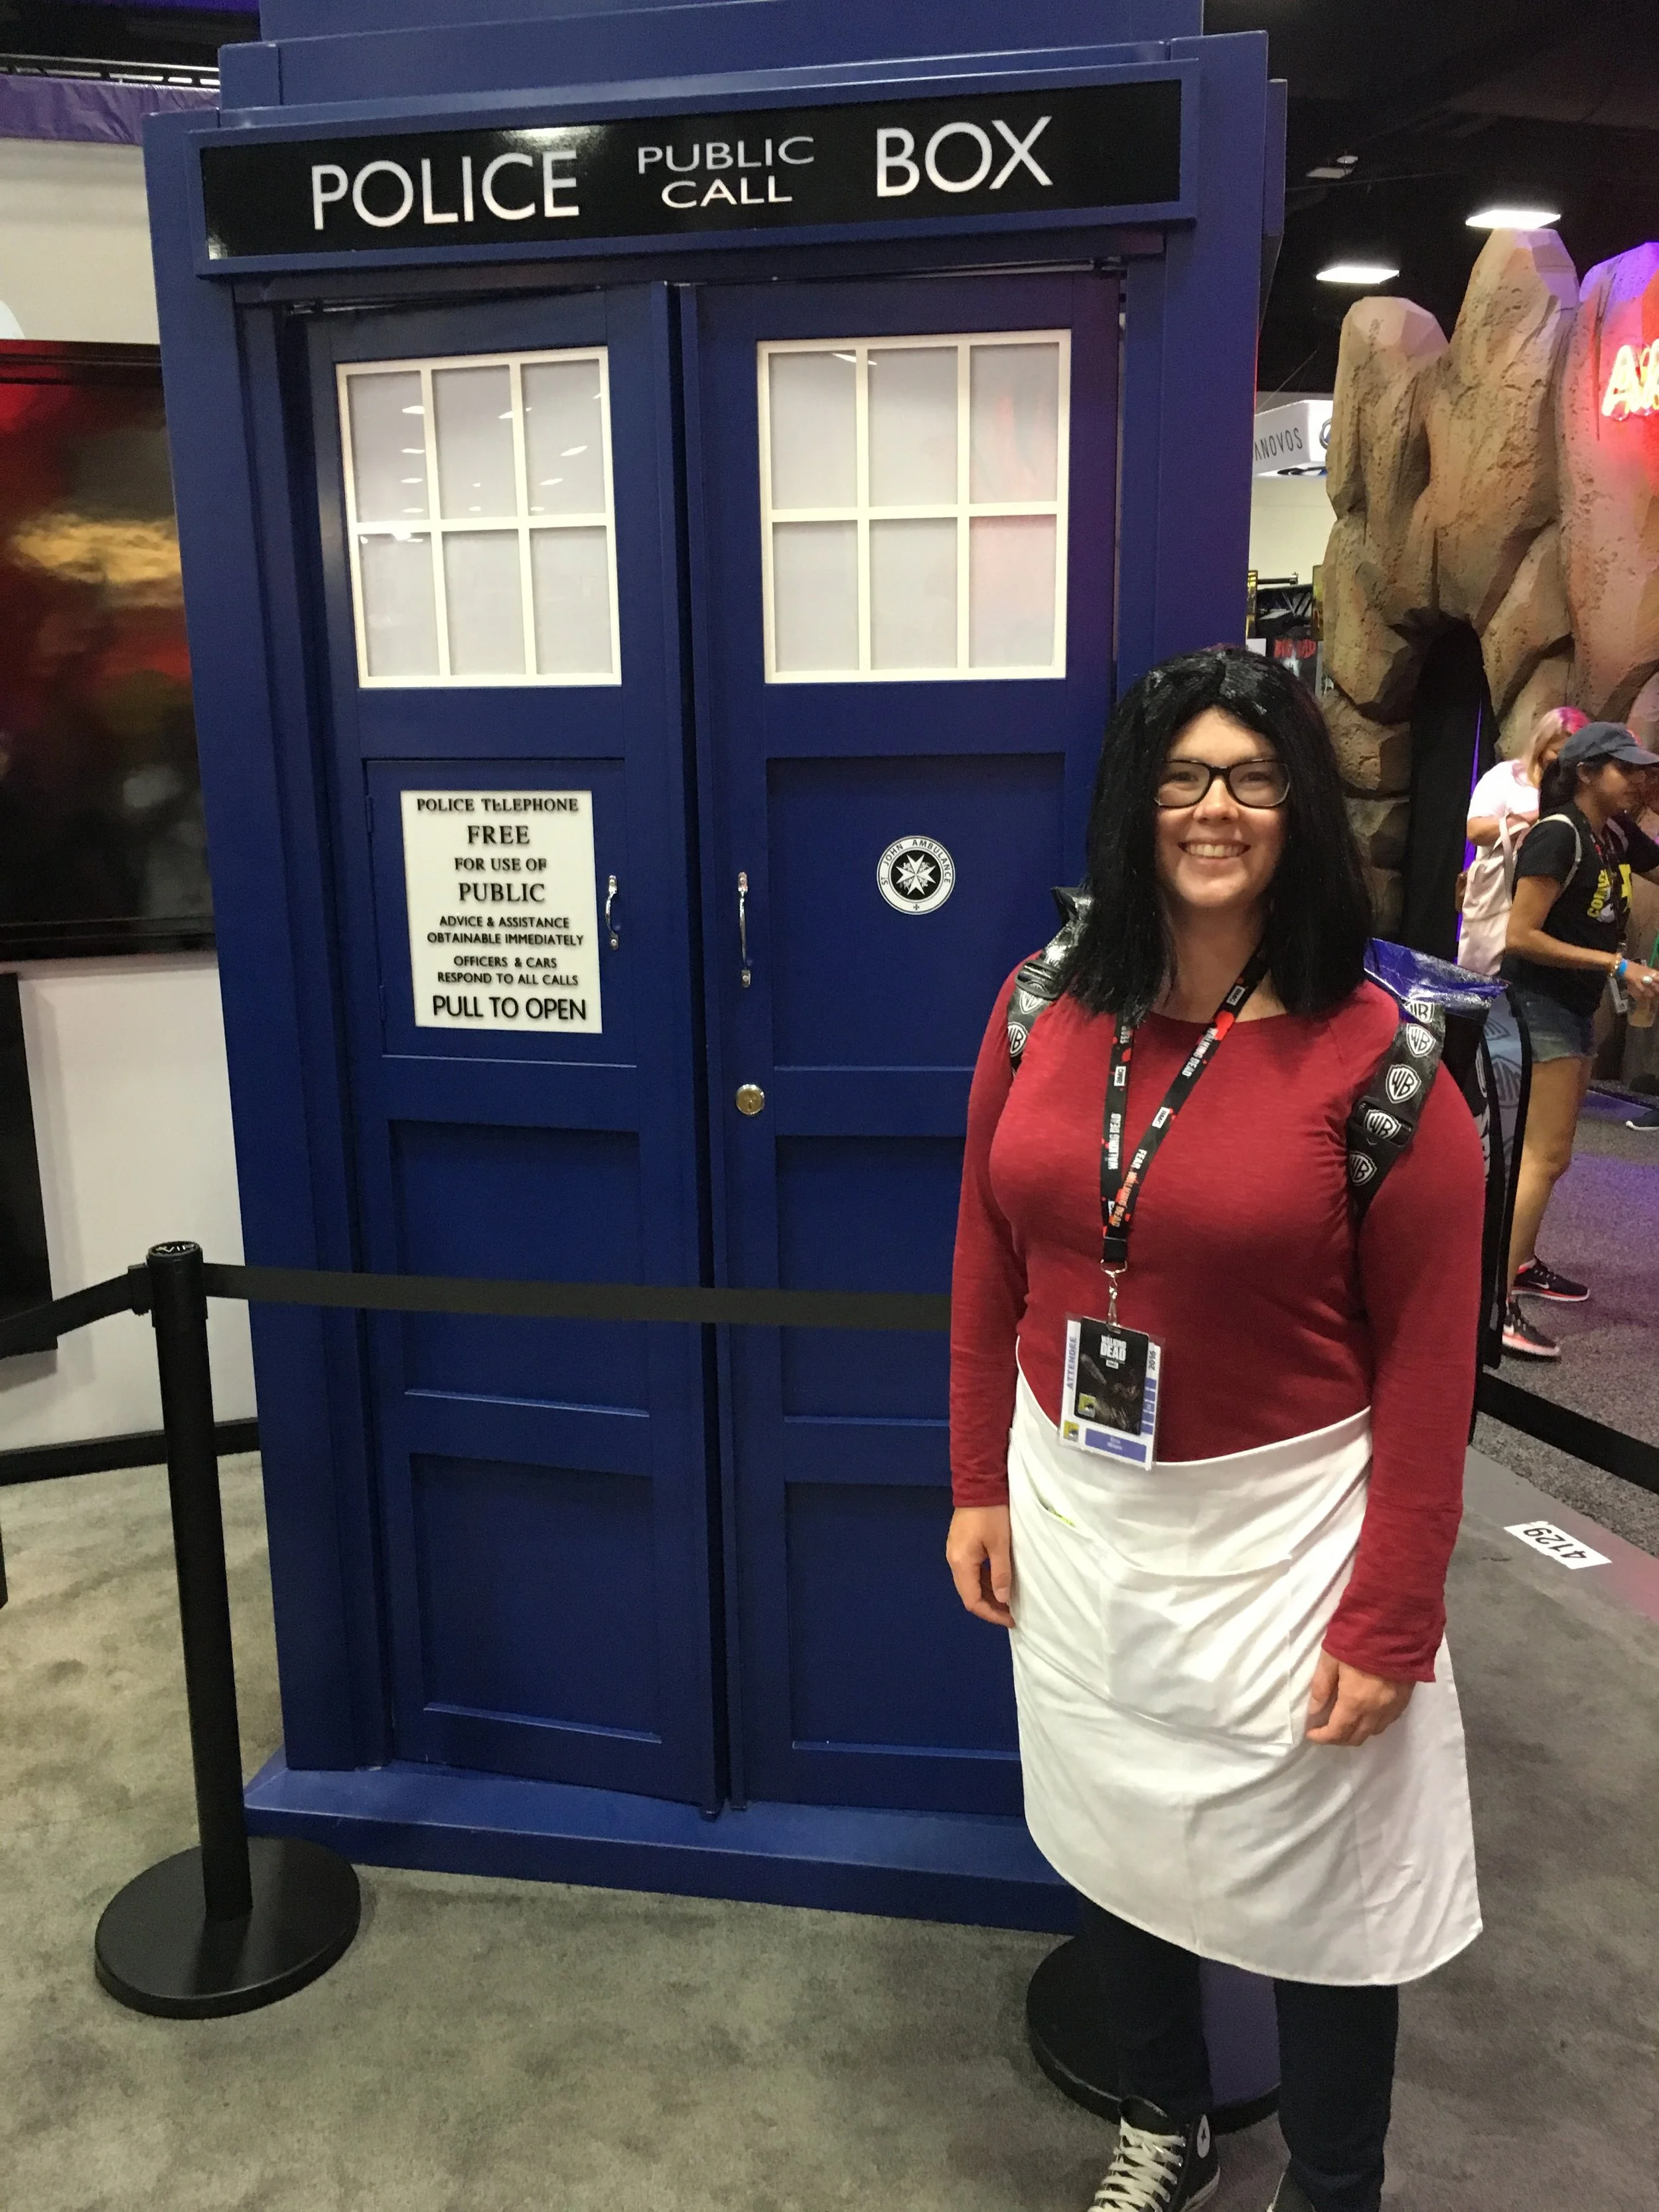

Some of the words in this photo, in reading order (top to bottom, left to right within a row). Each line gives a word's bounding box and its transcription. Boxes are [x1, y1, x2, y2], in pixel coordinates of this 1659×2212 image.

[638, 136, 814, 174] PUBLIC
[875, 115, 1053, 198] BOX
[311, 149, 579, 230] POLICE
[661, 175, 793, 208] CALL
[1254, 427, 1303, 461] ANOVOS
[417, 798, 474, 812] POLICE
[481, 798, 579, 812] TELEPHONE
[467, 825, 530, 845] FREE
[455, 857, 485, 871] FOR
[490, 857, 521, 871] USE
[526, 857, 547, 871] OF
[883, 843, 903, 866] JOHN
[912, 839, 952, 884] AMBULANCE
[459, 882, 545, 903] PUBLIC
[439, 915, 483, 927] ADVICE
[486, 917, 494, 928] &
[498, 917, 569, 928] ASSISTANCE
[427, 932, 501, 945] OBTAINABLE
[505, 933, 584, 946] IMMEDIATELY
[454, 955, 508, 968] OFFICERS
[514, 957, 522, 968] &
[526, 957, 557, 968] CARS
[437, 972, 492, 984] RESPOND
[496, 973, 514, 985] TO
[518, 974, 539, 985] ALL
[542, 974, 579, 986] CALLS
[432, 995, 484, 1017] PULL
[489, 996, 519, 1019] TO
[525, 997, 587, 1020] OPEN
[1182, 1056, 1200, 1077] DEAD
[1110, 1113, 1121, 1134] DEAD
[1131, 1149, 1147, 1169] FEAR
[1100, 1342, 1127, 1361] DEAD
[1066, 1336, 1077, 1391] ATTENDEE
[1523, 1527, 1587, 1559] 4129
